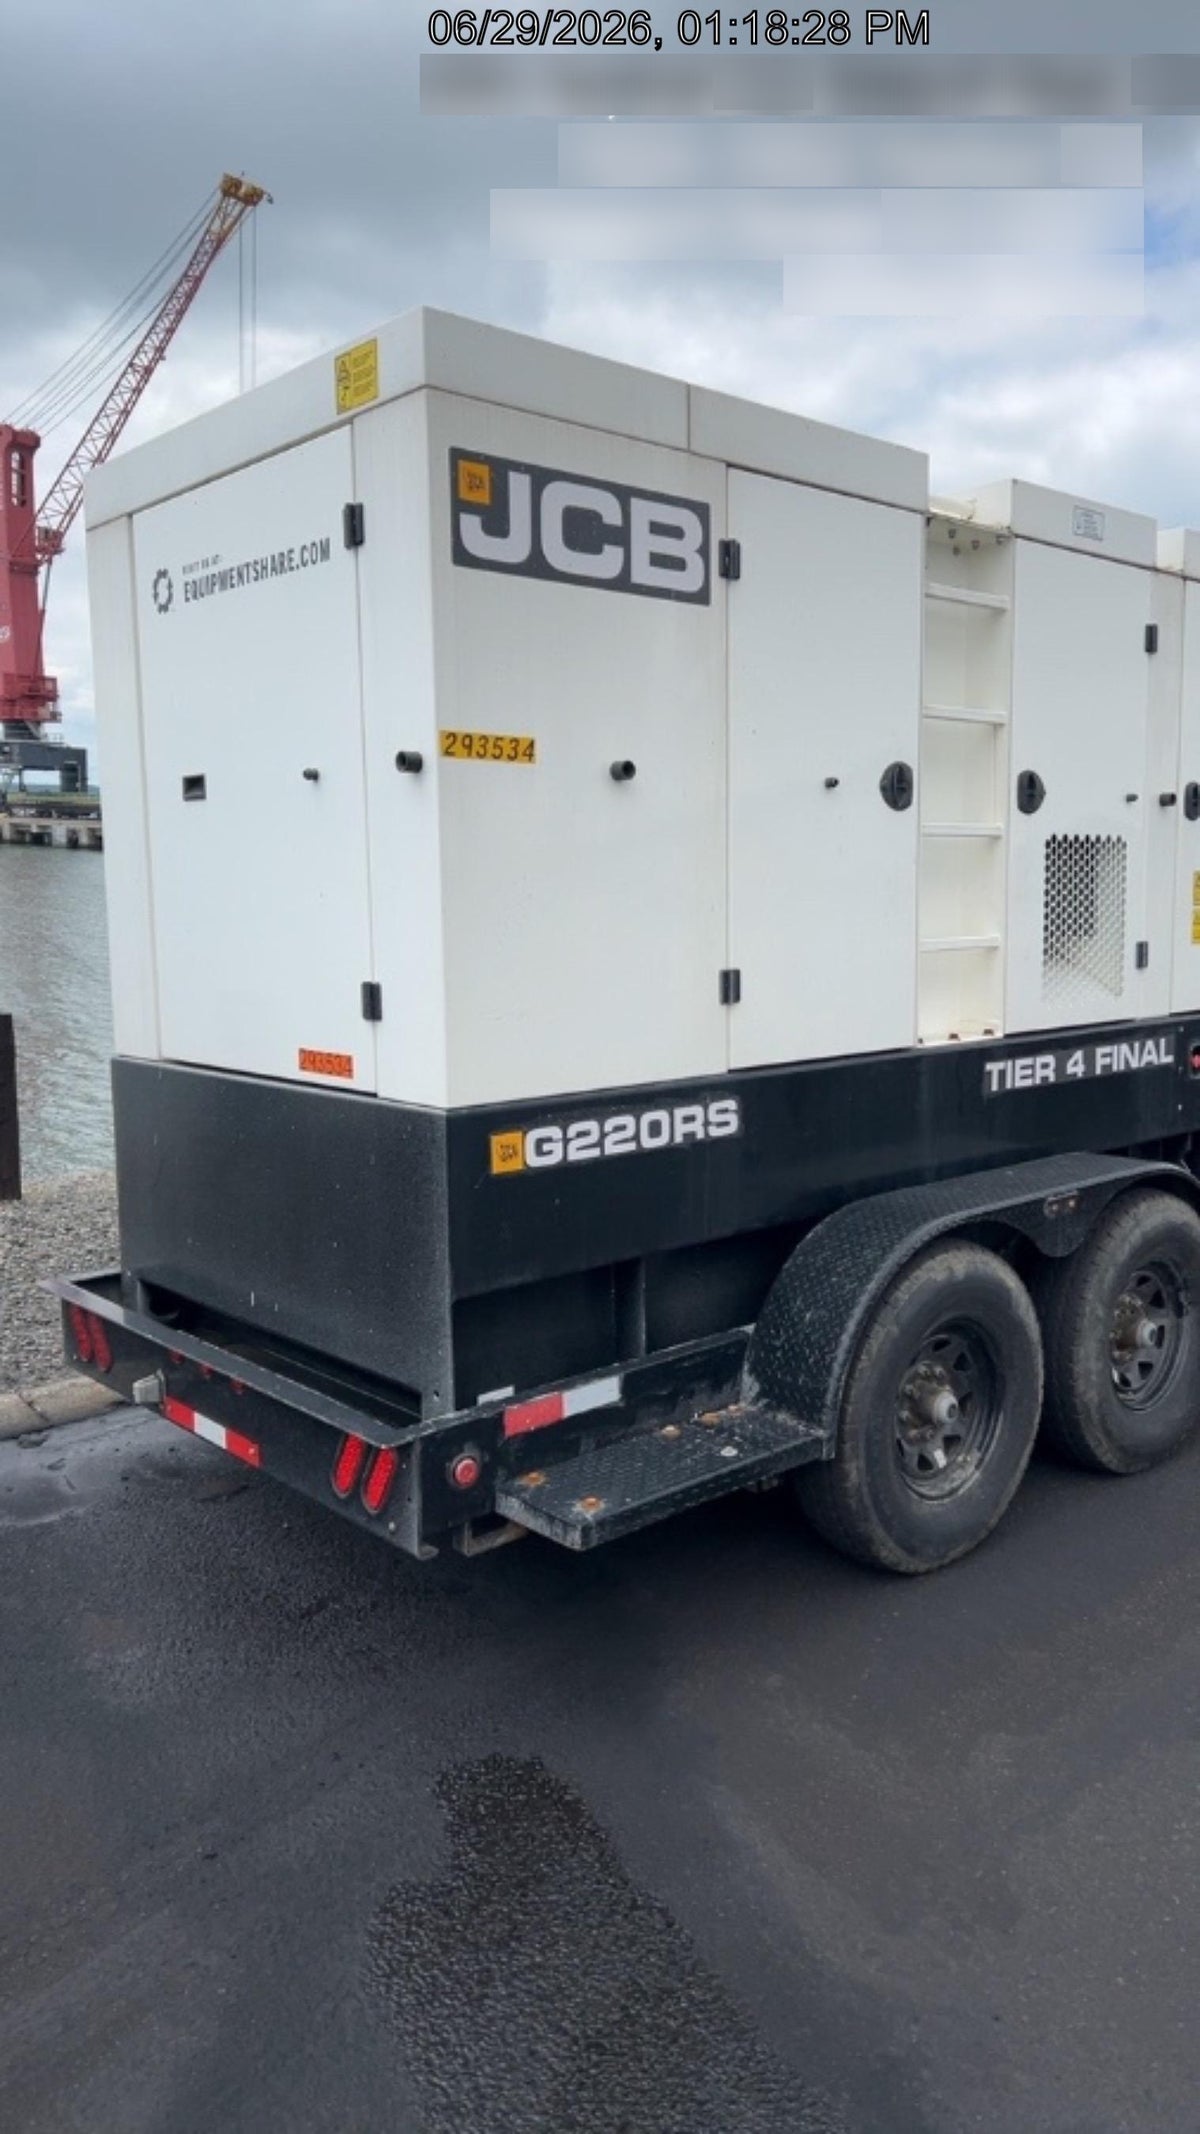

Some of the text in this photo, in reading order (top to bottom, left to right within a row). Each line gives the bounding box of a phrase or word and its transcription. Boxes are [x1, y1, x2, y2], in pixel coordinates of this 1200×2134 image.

[459, 470, 705, 593] JCB
[184, 537, 331, 603] EQUIPMENTSHARE.COM
[442, 732, 535, 762] 293534
[985, 1038, 1174, 1091] TIER 4 FINAL
[524, 1099, 739, 1168] G220RS
